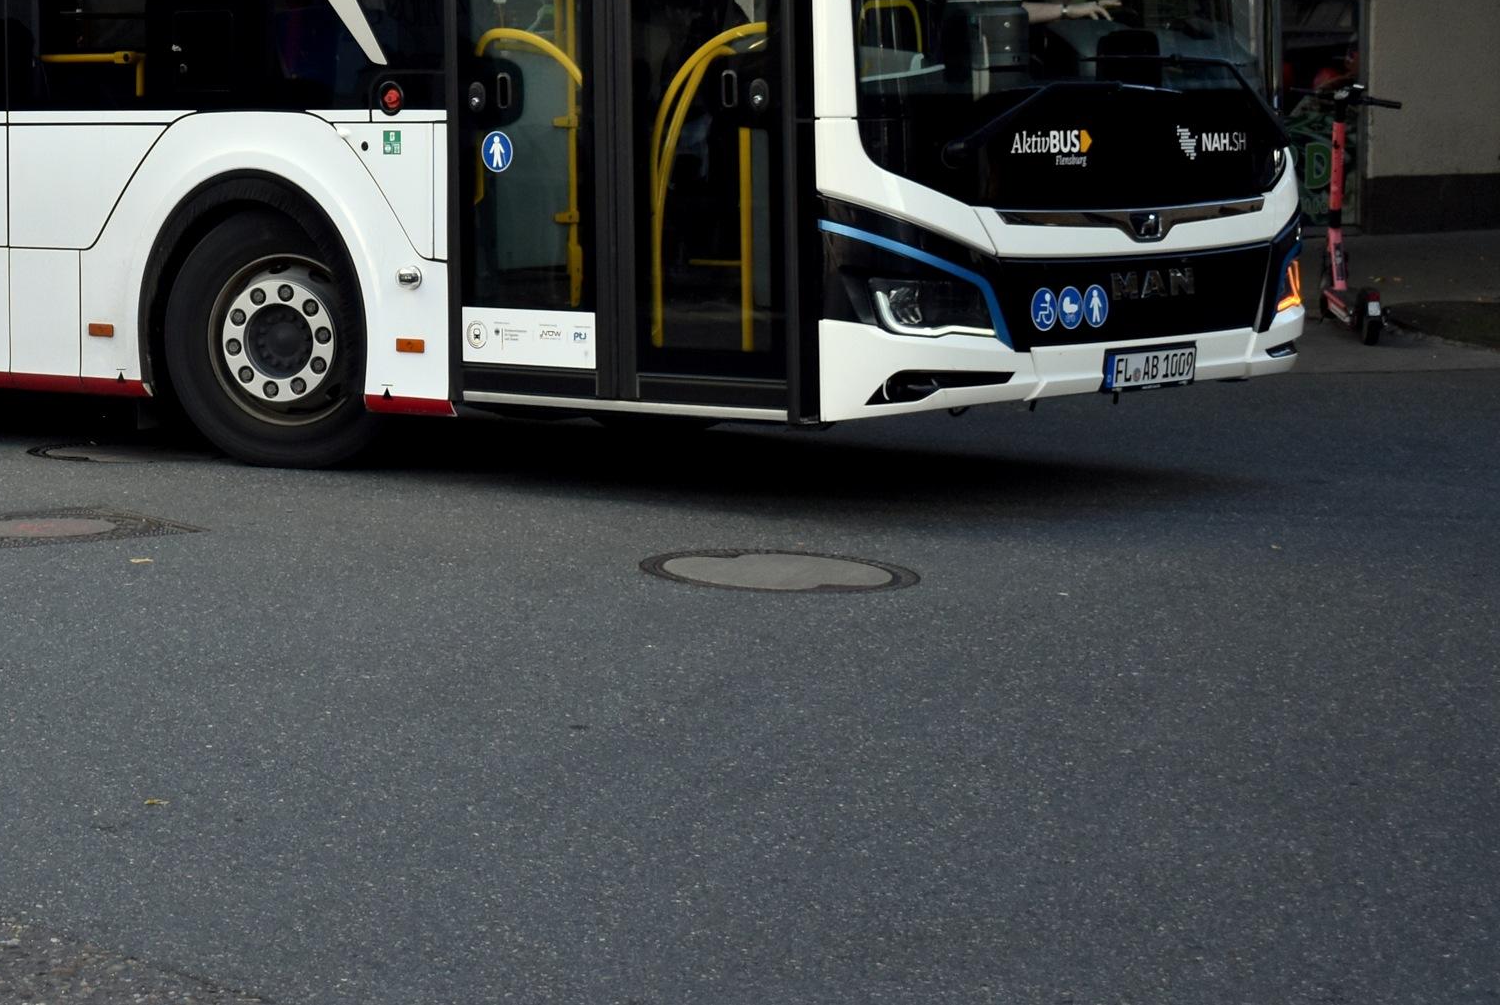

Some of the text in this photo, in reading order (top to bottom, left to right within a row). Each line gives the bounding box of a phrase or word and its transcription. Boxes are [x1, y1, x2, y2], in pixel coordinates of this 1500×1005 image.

[1010, 130, 1080, 154] AktivBUS
[1201, 131, 1247, 153] NAH.SH
[1055, 154, 1088, 167] Flensburg
[1110, 267, 1197, 300] MAN
[1114, 351, 1195, 384] FL AB 1009
